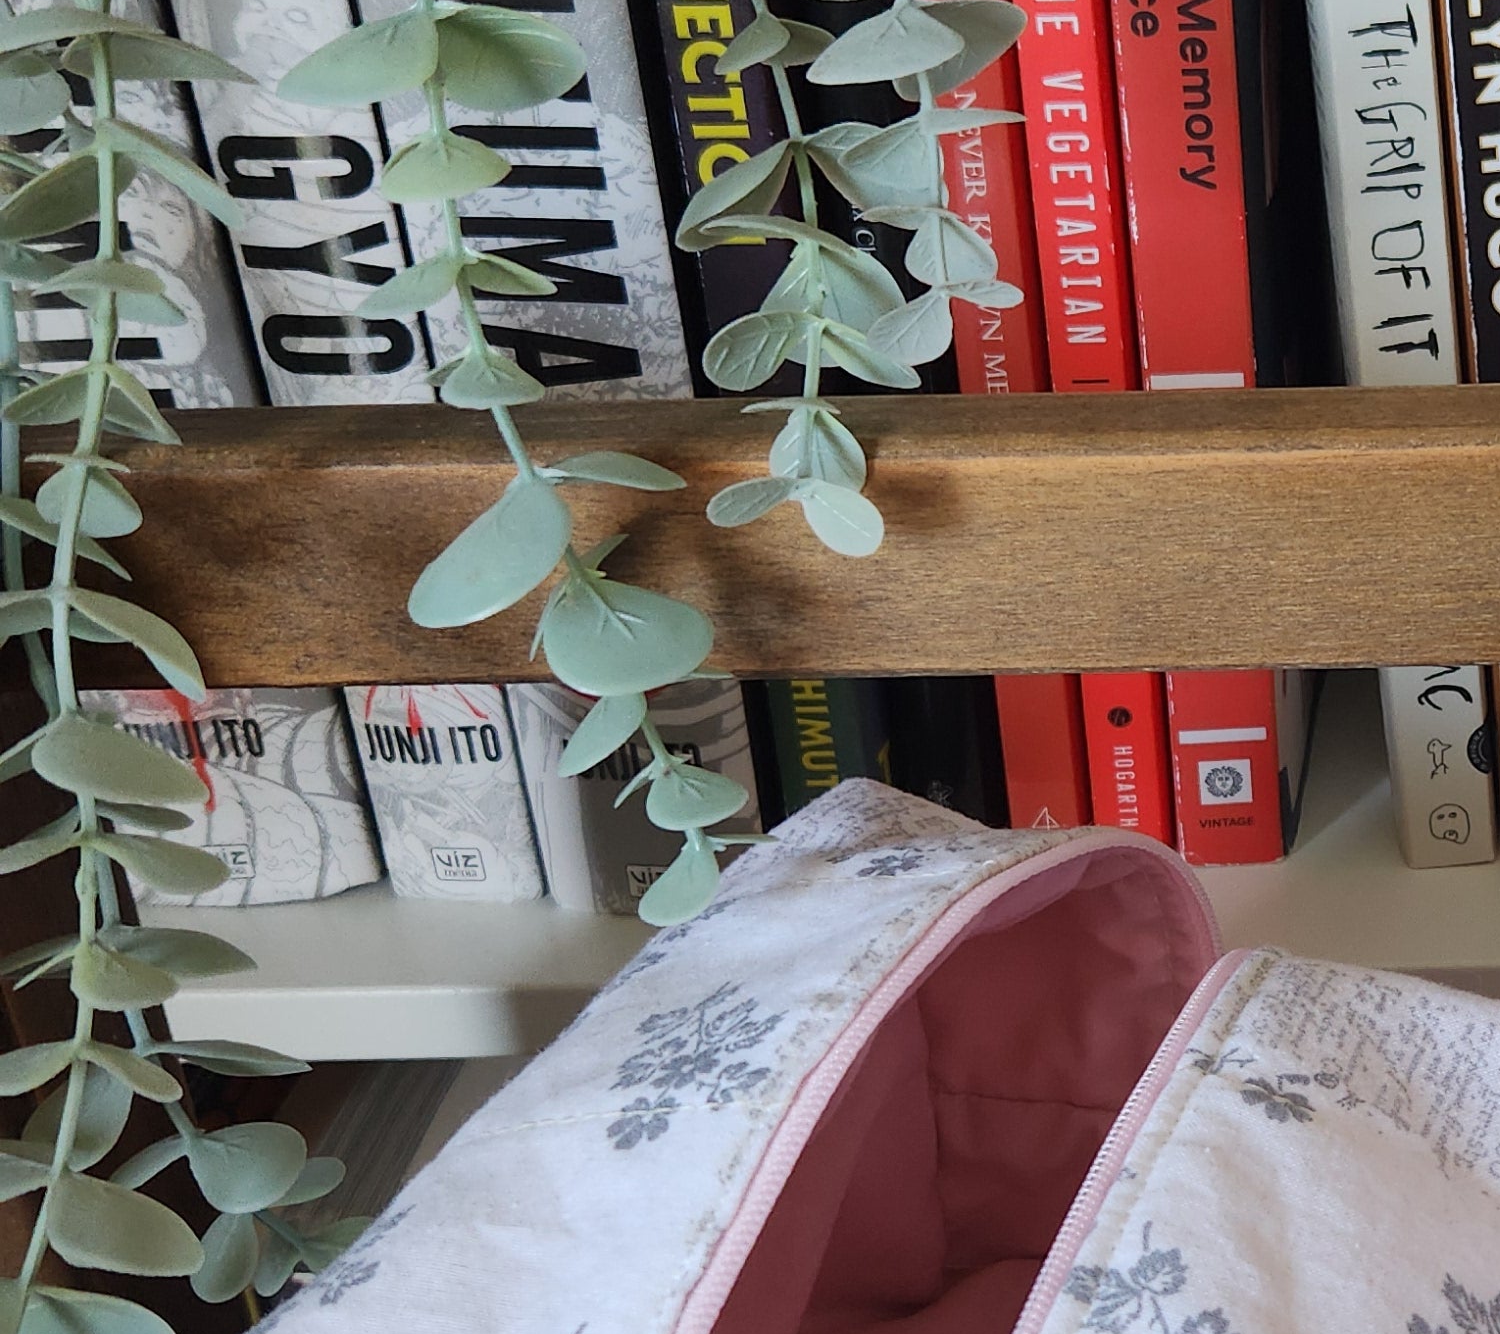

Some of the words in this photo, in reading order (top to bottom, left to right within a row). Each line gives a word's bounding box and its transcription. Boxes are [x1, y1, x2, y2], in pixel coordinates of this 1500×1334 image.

[1354, 104, 1428, 202] GRIP
[1041, 71, 1108, 346] VEGETARIAN
[217, 135, 415, 376] GYO
[1371, 220, 1432, 291] OF
[1372, 315, 1440, 363] IT
[212, 718, 265, 758] ITO
[363, 722, 442, 766] JUNJI
[448, 722, 503, 764] ITO
[1112, 745, 1140, 829] HOGARTH
[1199, 814, 1257, 830] VINTAGE
